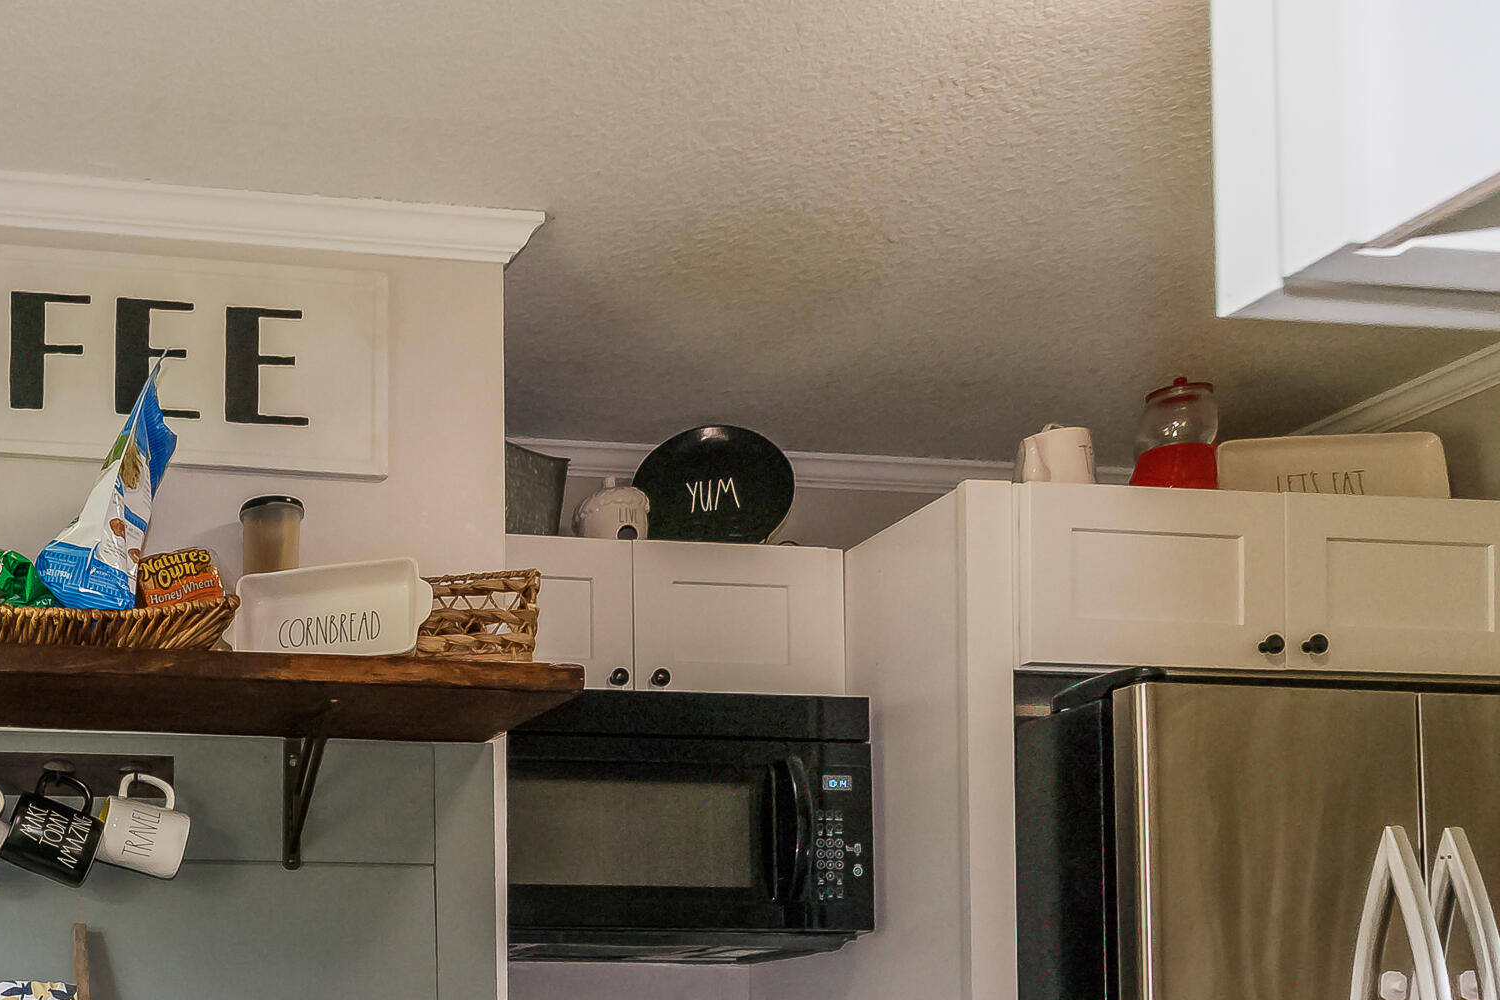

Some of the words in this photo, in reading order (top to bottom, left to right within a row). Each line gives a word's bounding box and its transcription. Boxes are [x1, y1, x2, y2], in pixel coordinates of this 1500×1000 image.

[685, 476, 741, 513] YUM
[1331, 469, 1365, 495] EAT
[138, 549, 210, 580] Nature's
[158, 561, 197, 588] Own
[149, 588, 183, 604] Honey
[181, 578, 214, 594] Wheat
[278, 610, 381, 649] CORNBREAD
[19, 802, 49, 842] MAKE
[38, 809, 70, 849] TODAY
[56, 812, 93, 870] AMAZING
[121, 808, 162, 858] TRAVEL
